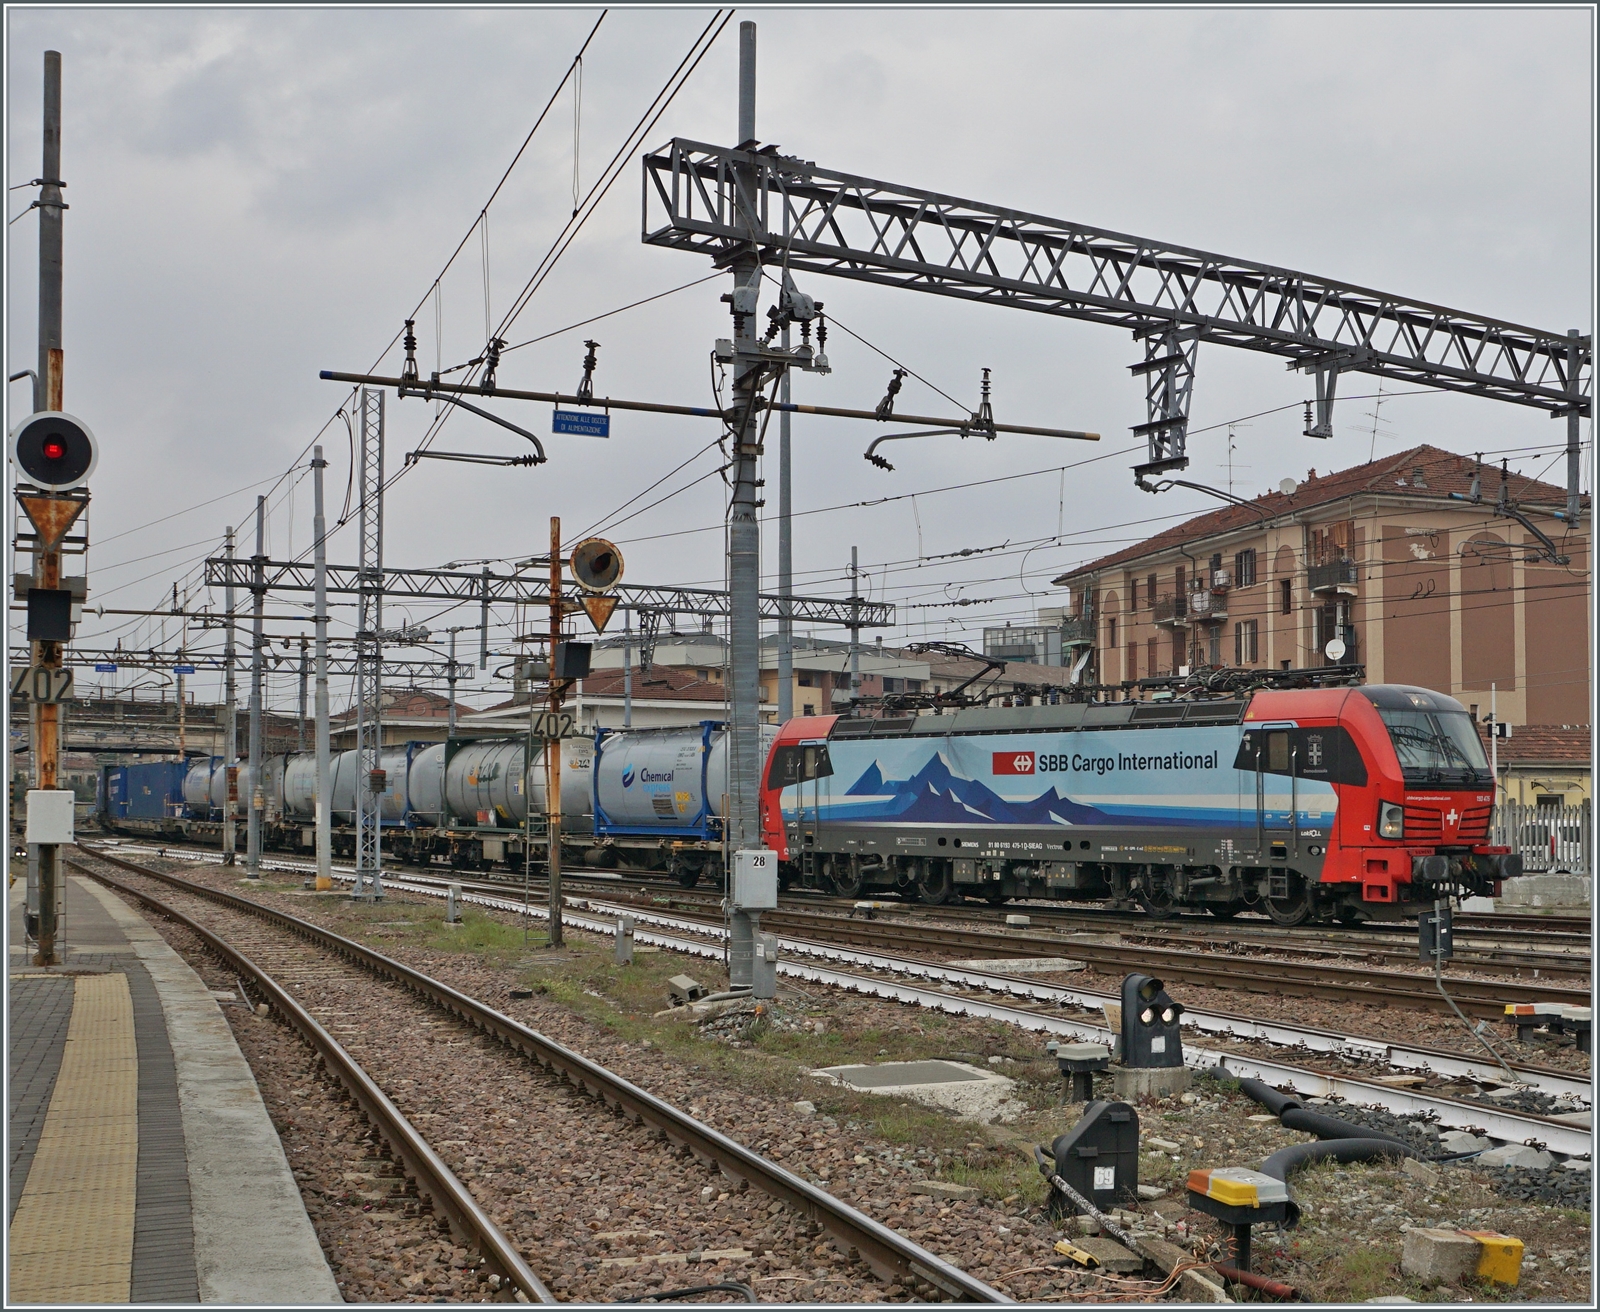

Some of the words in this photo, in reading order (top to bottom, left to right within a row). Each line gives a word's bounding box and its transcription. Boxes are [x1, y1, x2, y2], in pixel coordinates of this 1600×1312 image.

[556, 414, 579, 423] ATTENZIONE
[561, 423, 566, 431] DI
[567, 424, 601, 434] ALIMENTAZIONE
[11, 668, 73, 702] 402
[534, 713, 572, 739] 402
[1039, 754, 1068, 772] SBB
[1072, 753, 1115, 776] Cargo
[1118, 750, 1217, 771] International
[641, 767, 674, 782] Chemical
[643, 783, 671, 798] express
[753, 856, 765, 867] 28
[1094, 1168, 1114, 1185] 69
